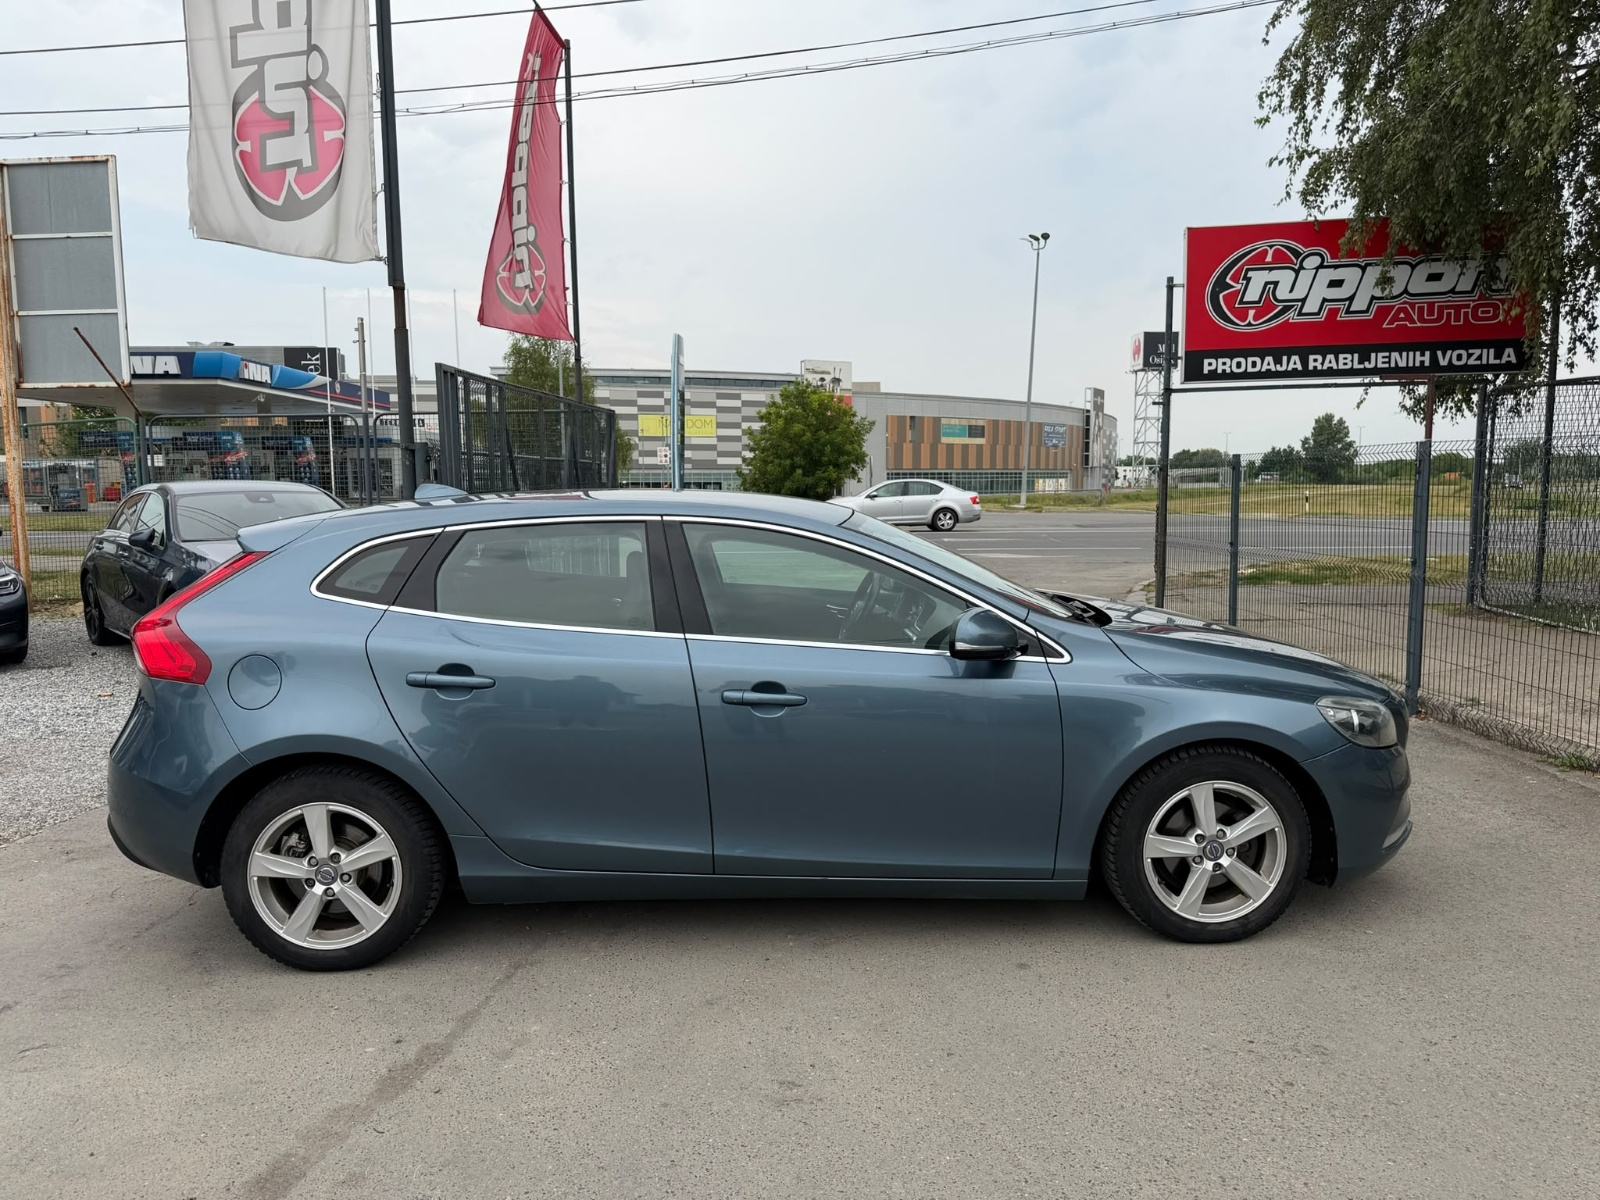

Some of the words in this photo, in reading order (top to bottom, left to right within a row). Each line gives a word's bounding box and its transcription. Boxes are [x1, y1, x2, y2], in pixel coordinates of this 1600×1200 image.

[1239, 250, 1512, 315] nippon
[1383, 301, 1502, 328] AUTO
[130, 355, 182, 375] NA
[1203, 354, 1302, 374] PRODAJA
[1308, 351, 1430, 371] RABLJENIH
[1437, 347, 1517, 367] VOZILA
